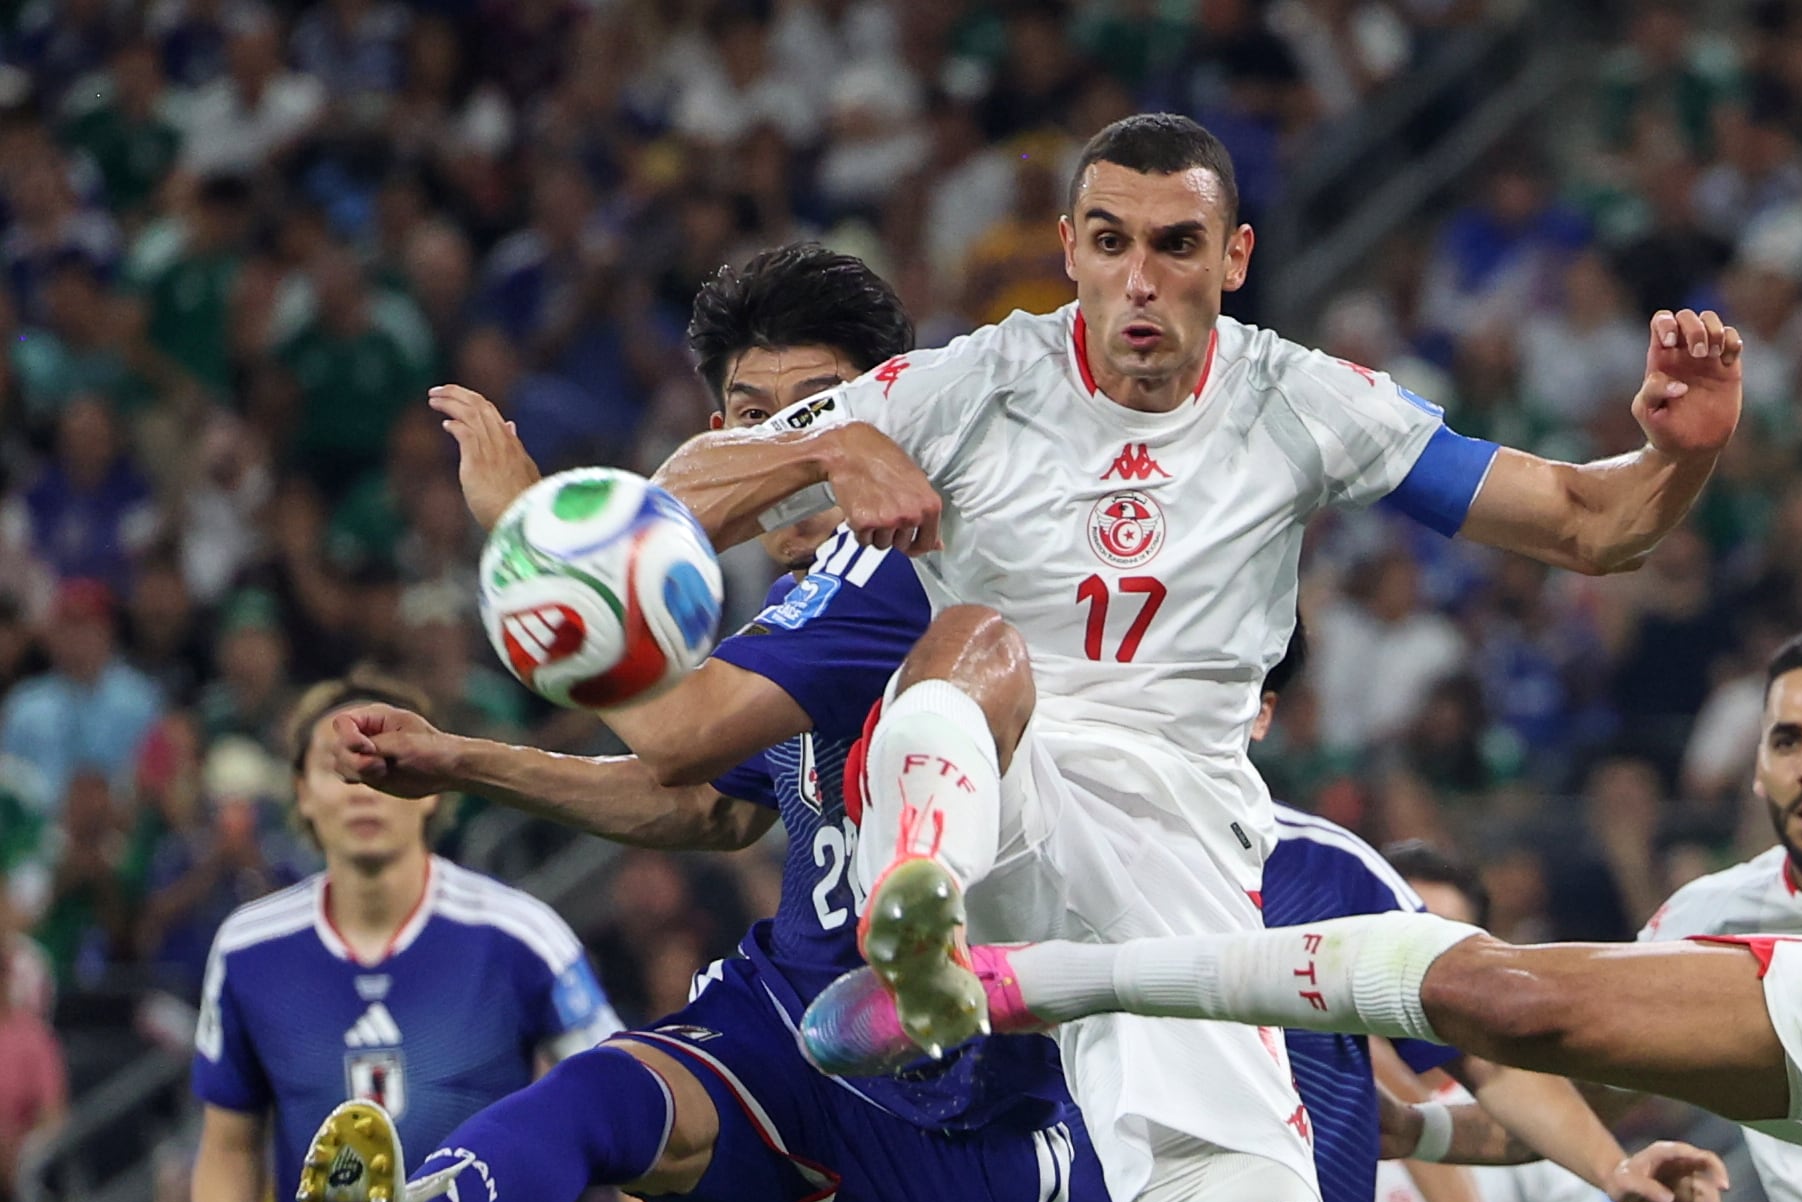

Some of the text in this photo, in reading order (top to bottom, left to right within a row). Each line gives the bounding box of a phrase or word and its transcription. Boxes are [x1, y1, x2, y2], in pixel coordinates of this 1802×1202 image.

[1076, 574, 1167, 663] 17
[903, 754, 976, 793] FTF
[1293, 933, 1328, 1012] FTF
